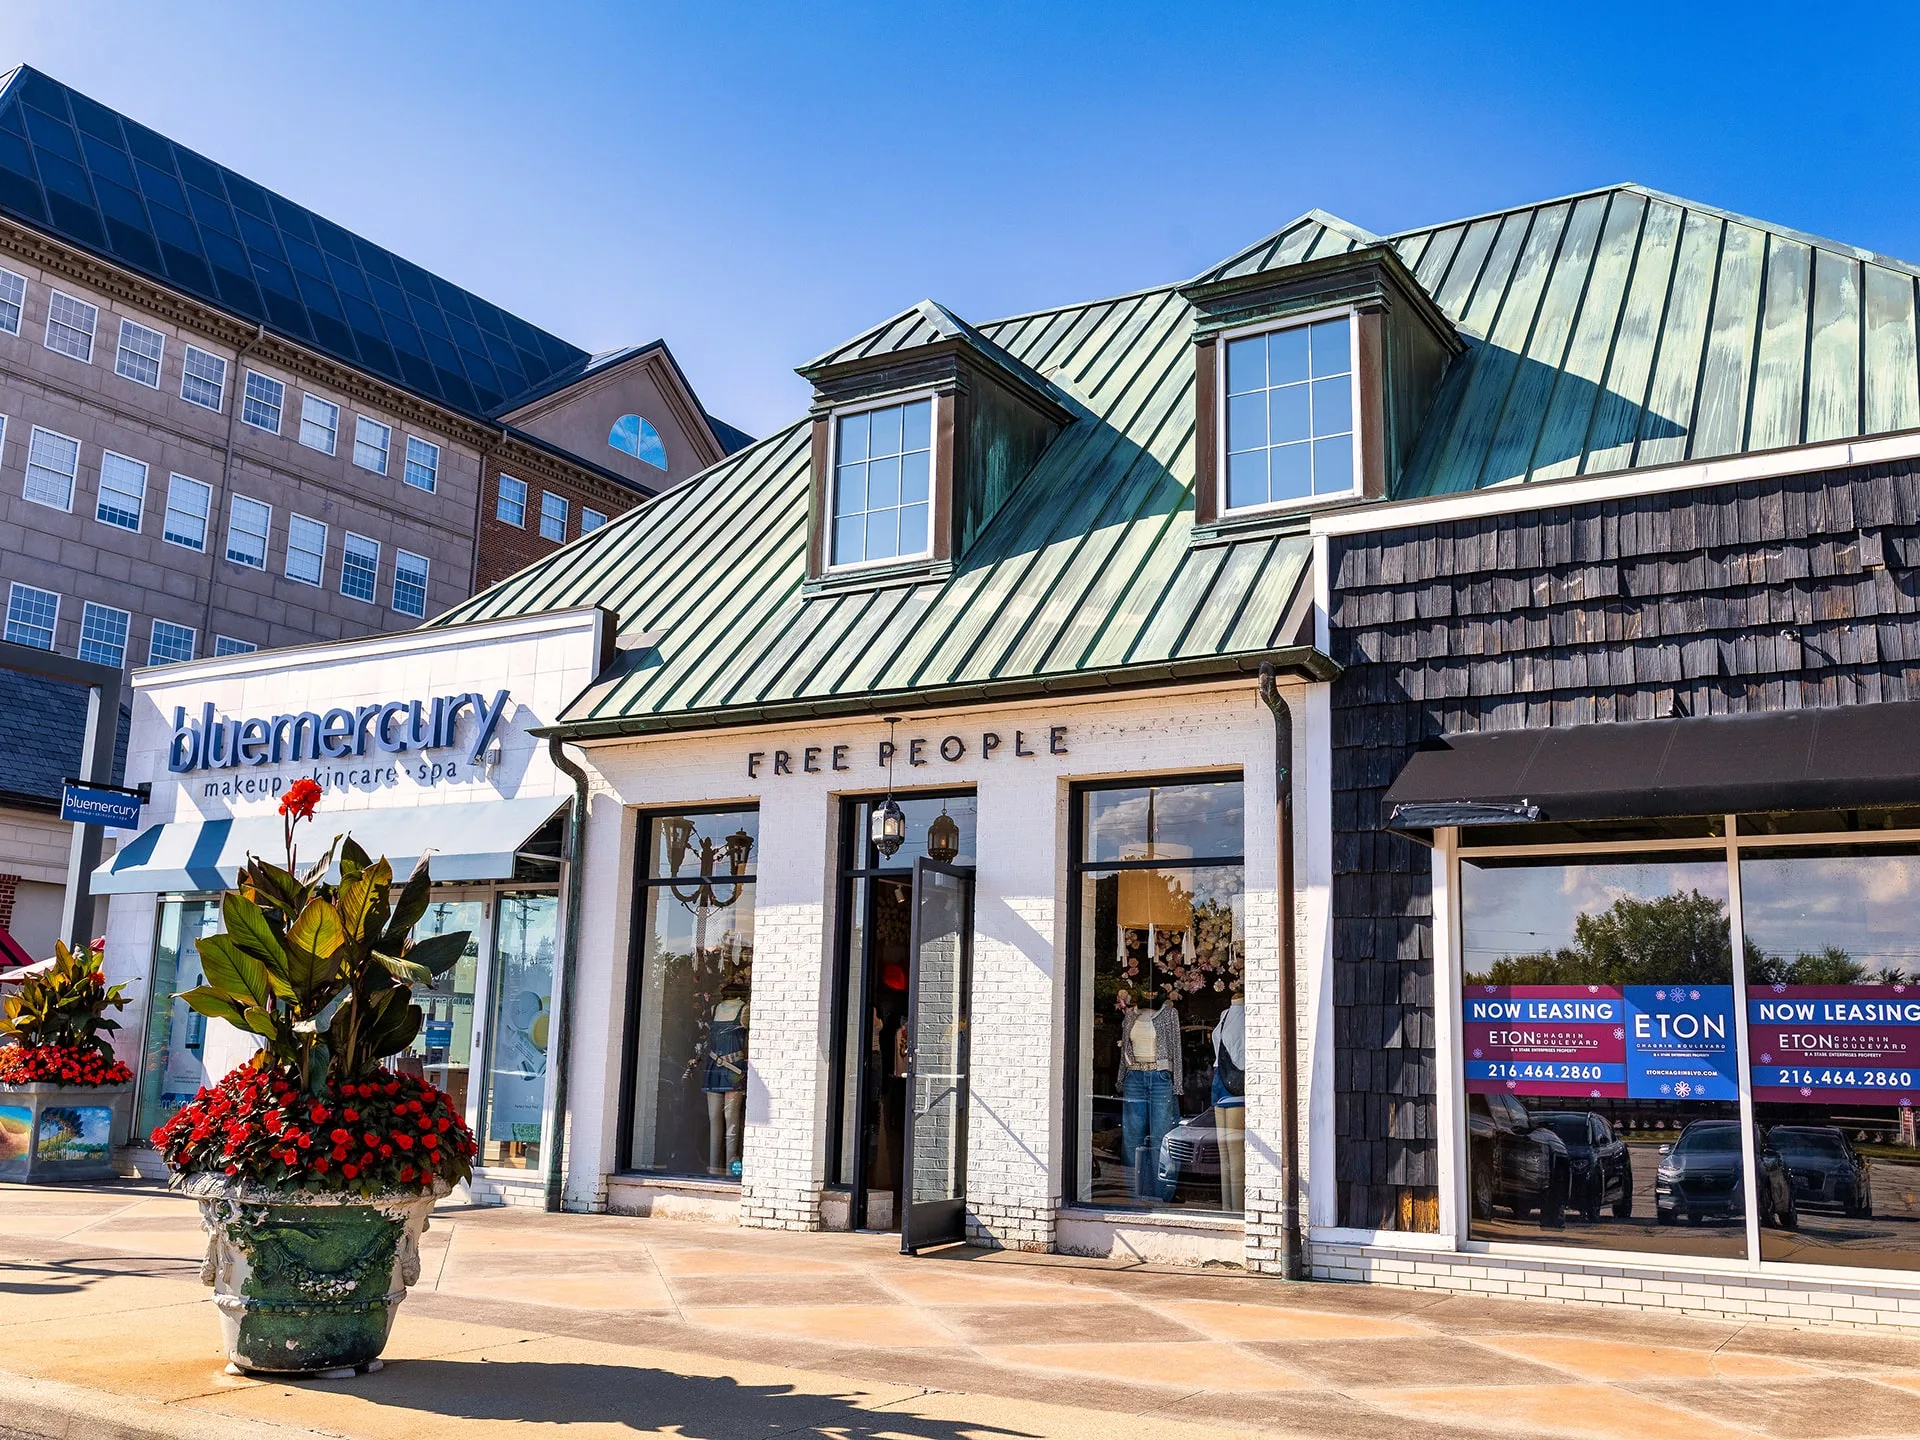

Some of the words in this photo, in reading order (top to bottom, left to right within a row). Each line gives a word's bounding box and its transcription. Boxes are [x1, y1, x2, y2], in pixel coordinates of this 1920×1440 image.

[168, 690, 511, 773] bluemercury
[748, 744, 850, 778] FREE
[879, 726, 1068, 767] PEOPLE
[204, 775, 282, 797] makeup
[418, 762, 457, 784] spa
[66, 794, 138, 819] bluemercury
[1473, 1003, 1521, 1019] NOW
[1529, 1003, 1613, 1020] LEASING
[1760, 1004, 1815, 1021] NOW
[1825, 1004, 1920, 1022] LEASING
[1635, 1013, 1725, 1039] ETON
[1489, 1030, 1535, 1045] ETON
[1779, 1033, 1832, 1049] ETON
[1834, 1042, 1907, 1050] BOULEVARD
[1488, 1064, 1602, 1080] 216.464.2860
[1779, 1069, 1912, 1087] 216.464.2860
